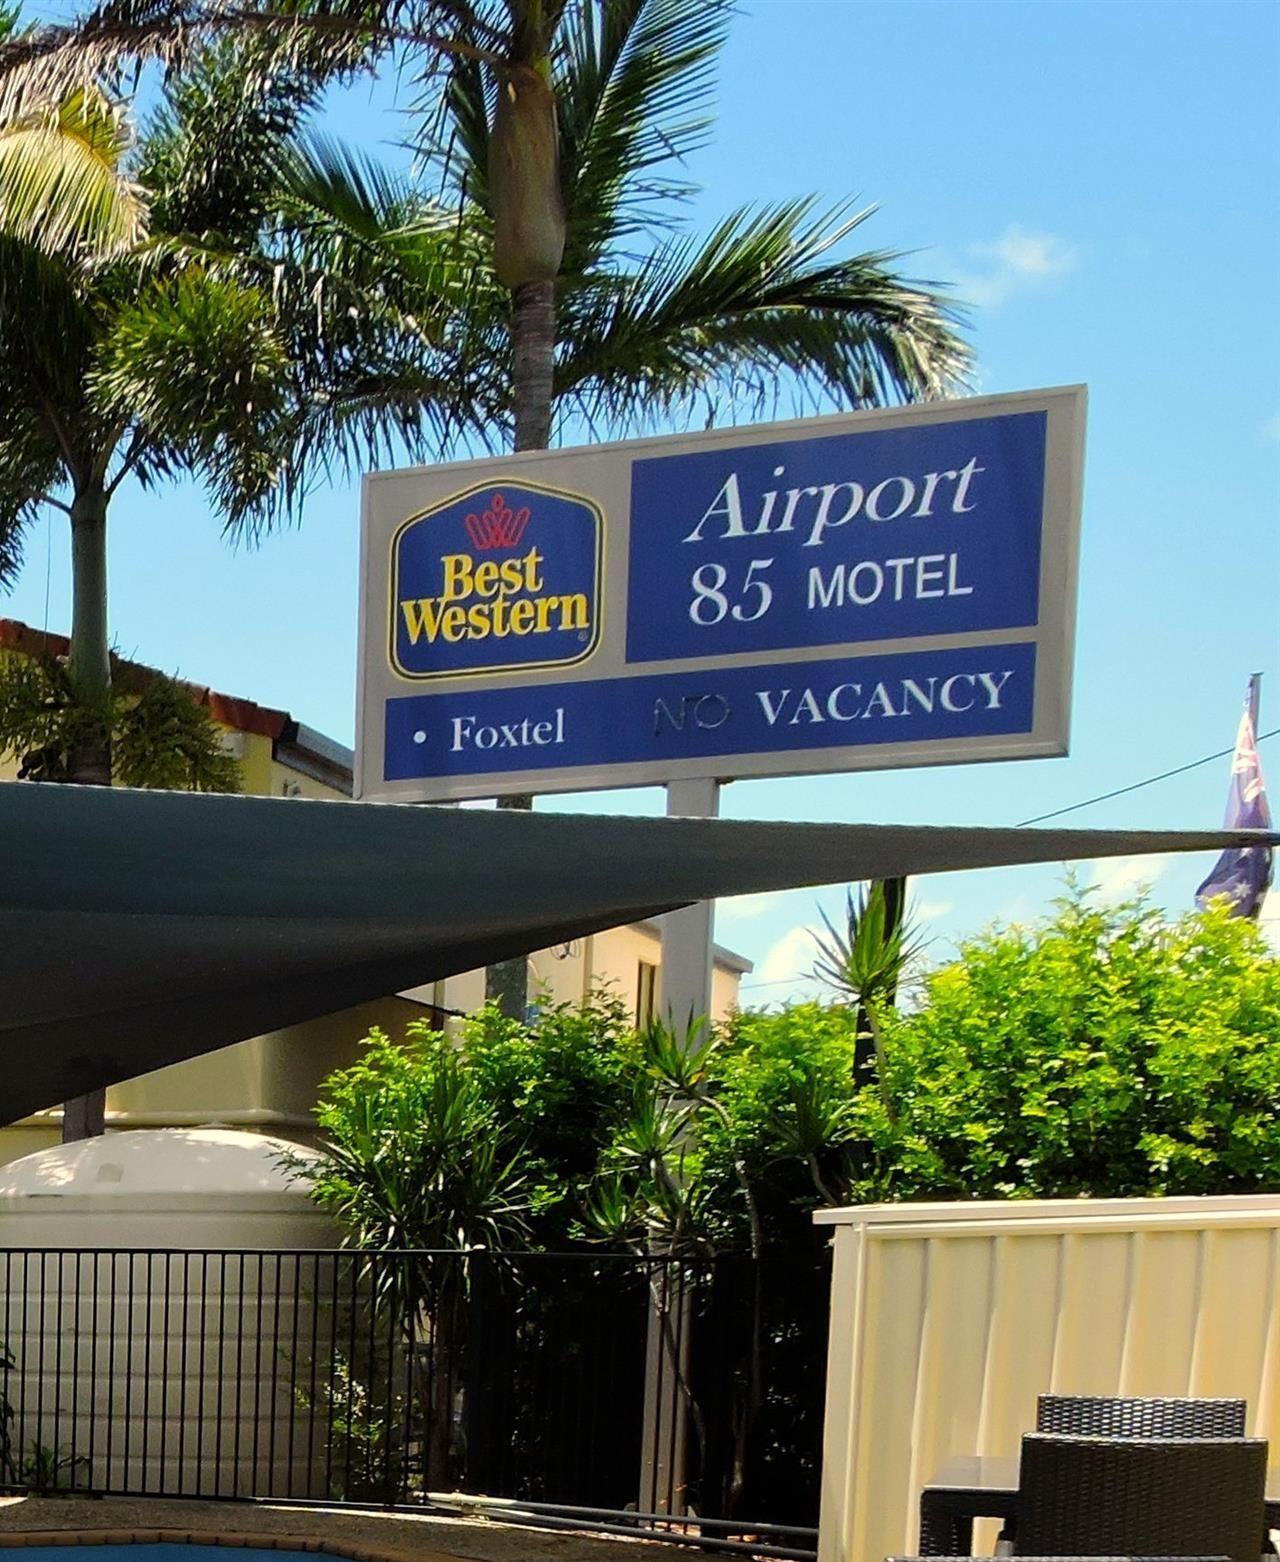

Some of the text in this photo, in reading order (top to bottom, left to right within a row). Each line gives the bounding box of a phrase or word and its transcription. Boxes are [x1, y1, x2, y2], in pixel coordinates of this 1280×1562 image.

[683, 456, 986, 548] Airport
[441, 546, 544, 600] Best
[689, 553, 973, 626] 85 MOTEL
[400, 591, 590, 646] Western
[450, 708, 566, 753] Foxtel
[651, 670, 1014, 736] NO VACANCY
